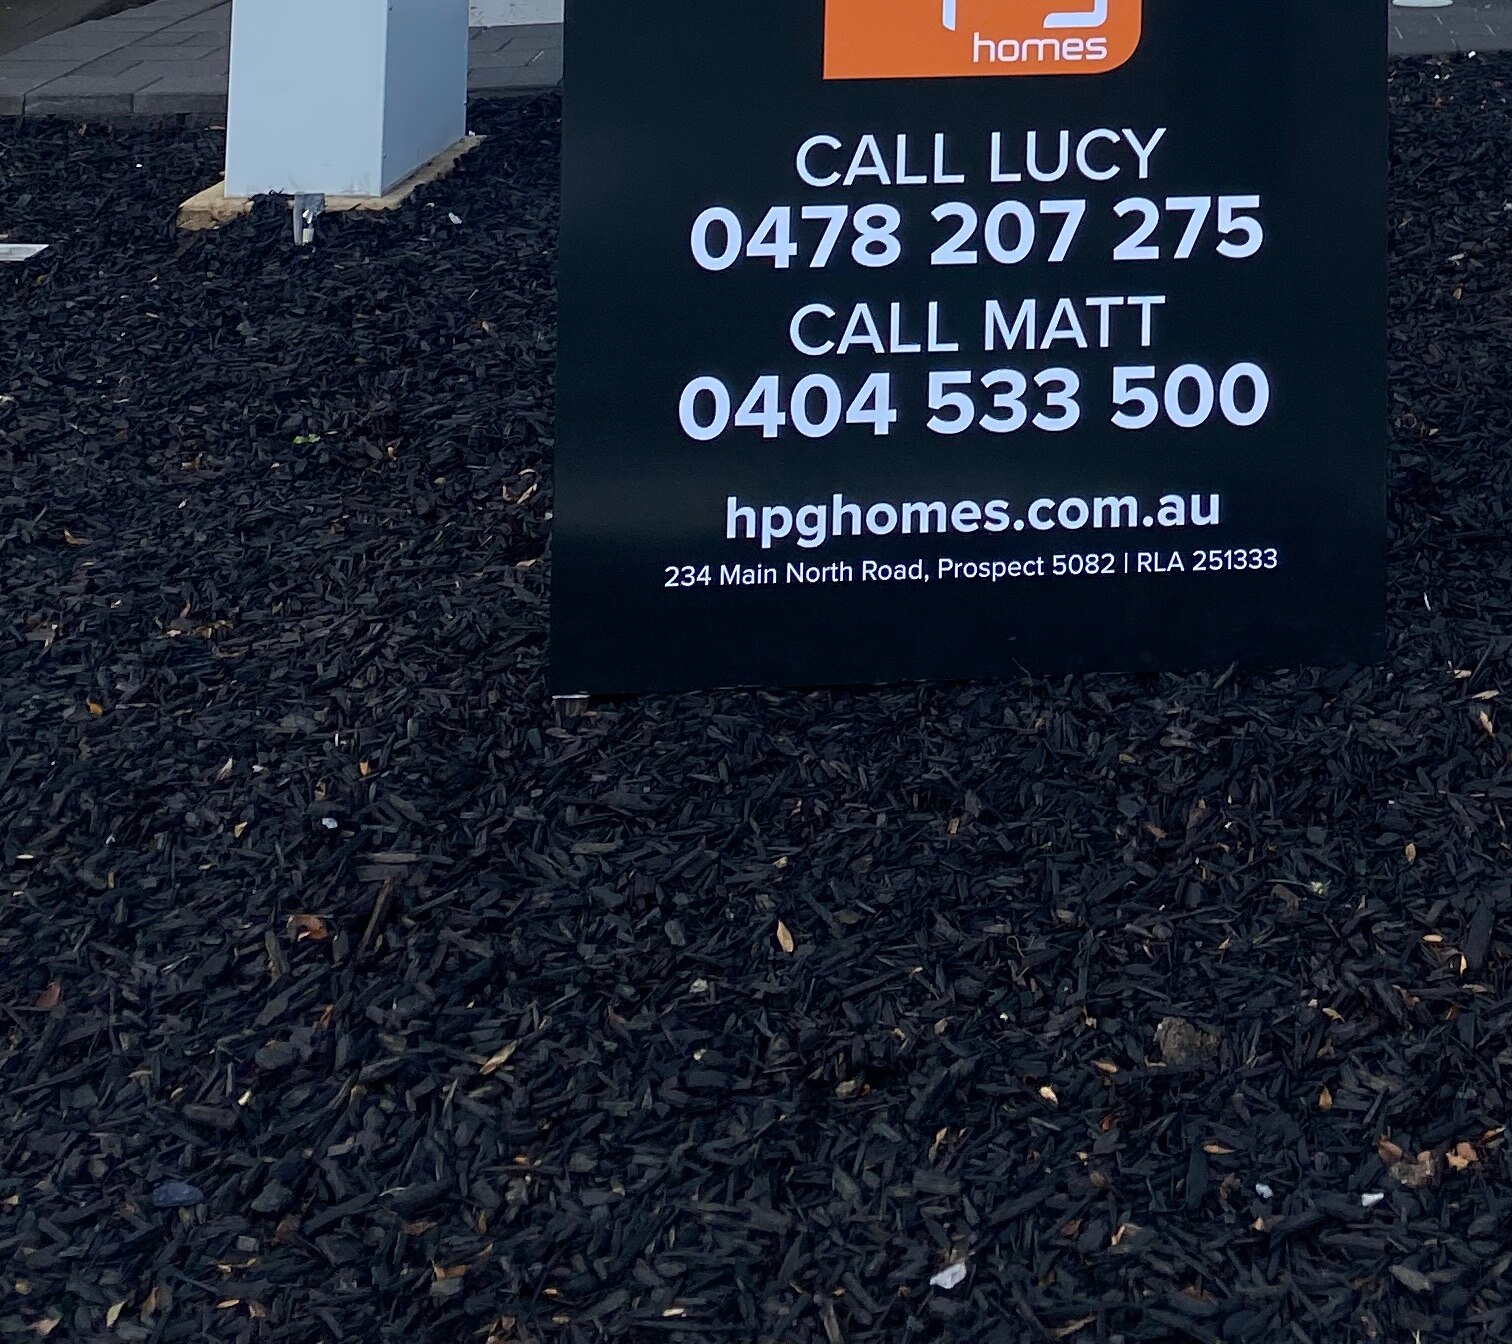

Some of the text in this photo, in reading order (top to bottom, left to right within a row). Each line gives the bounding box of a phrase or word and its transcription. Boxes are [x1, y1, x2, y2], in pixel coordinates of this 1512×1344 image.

[974, 33, 1108, 63] homes
[797, 128, 1167, 186] CALL LUCY
[690, 194, 1264, 271] 0478 207 275
[790, 296, 1166, 356] CALL MATT
[679, 362, 1270, 441] 0404 533 500
[726, 493, 1222, 549] hpghomes.com.au
[664, 564, 712, 588] 234
[720, 563, 777, 586] Main
[786, 560, 853, 584] North
[862, 558, 930, 583] Road,
[938, 556, 1045, 583] Prospect
[1052, 552, 1116, 576] 5082
[1137, 550, 1185, 573] RLA
[1192, 547, 1278, 572] 251333
